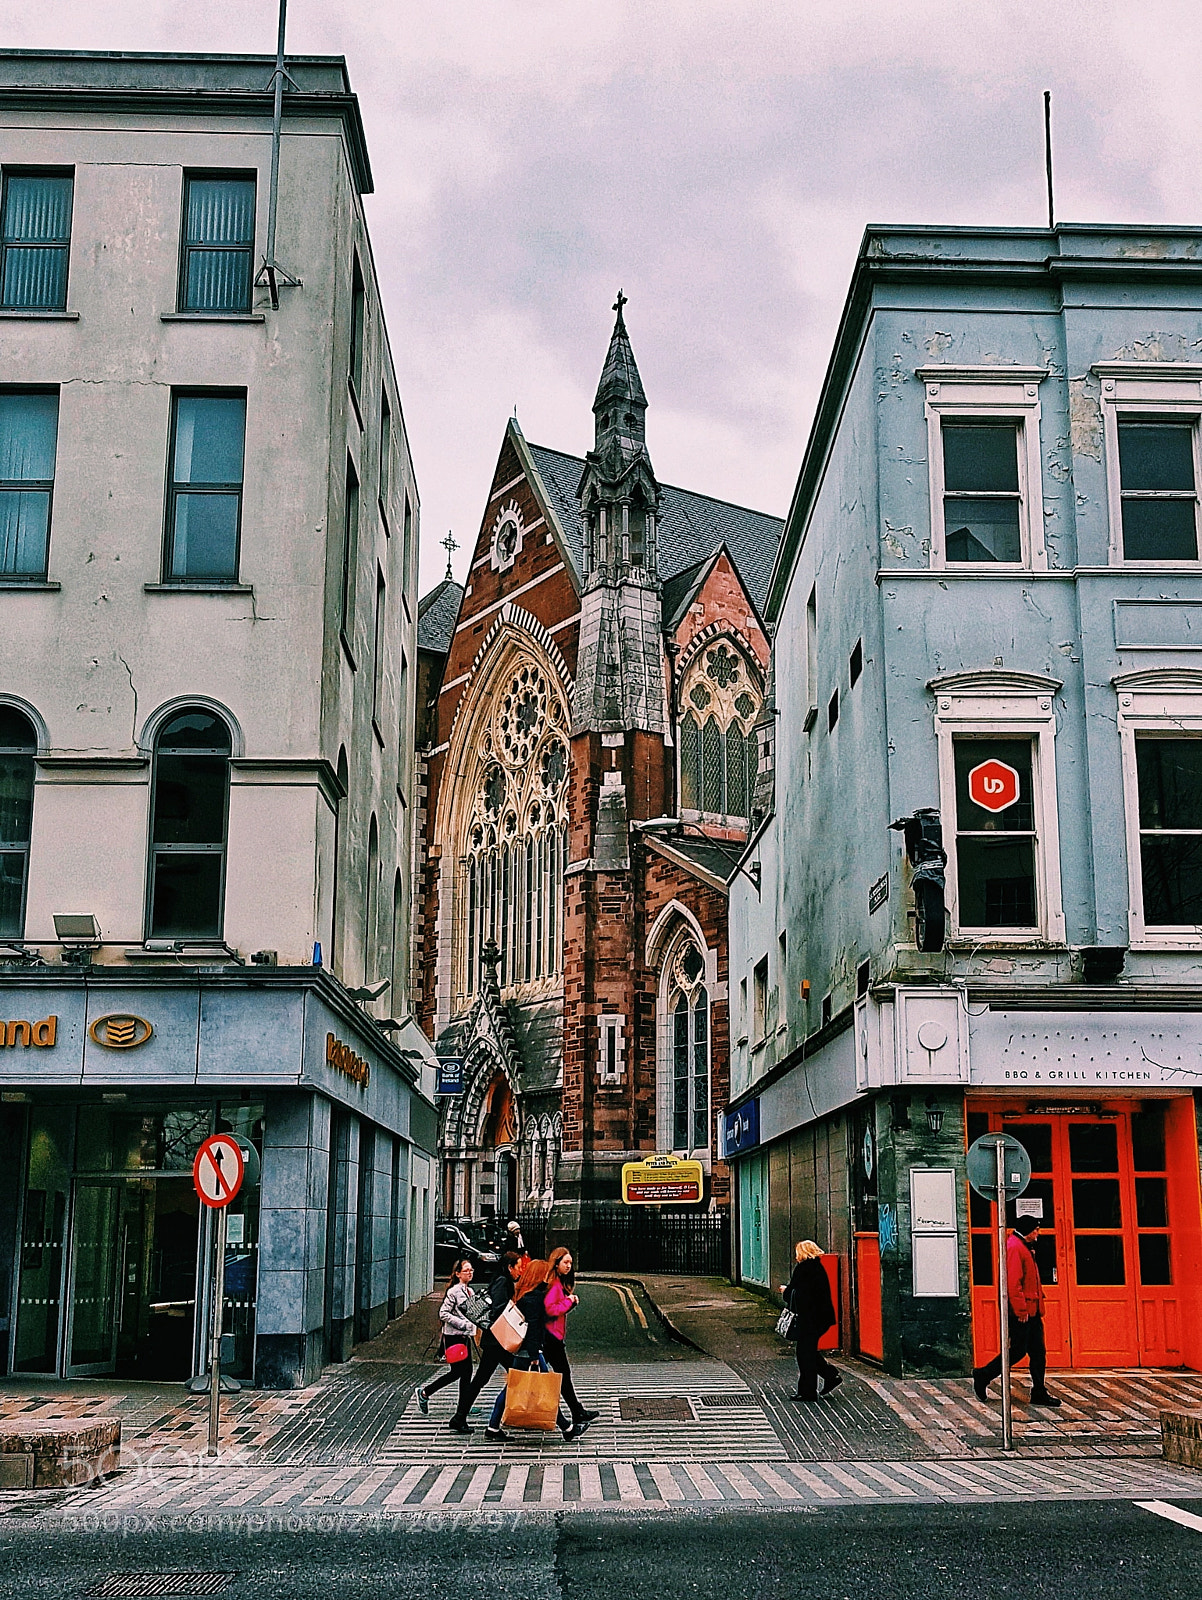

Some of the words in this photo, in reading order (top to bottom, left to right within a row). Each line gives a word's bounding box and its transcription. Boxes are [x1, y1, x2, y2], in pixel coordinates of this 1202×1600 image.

[0, 1015, 57, 1047] nd
[1005, 1070, 1028, 1079] BBQ
[1034, 1070, 1041, 1079] &
[1048, 1070, 1087, 1079] GRILL
[1095, 1070, 1151, 1080] KITCHEN
